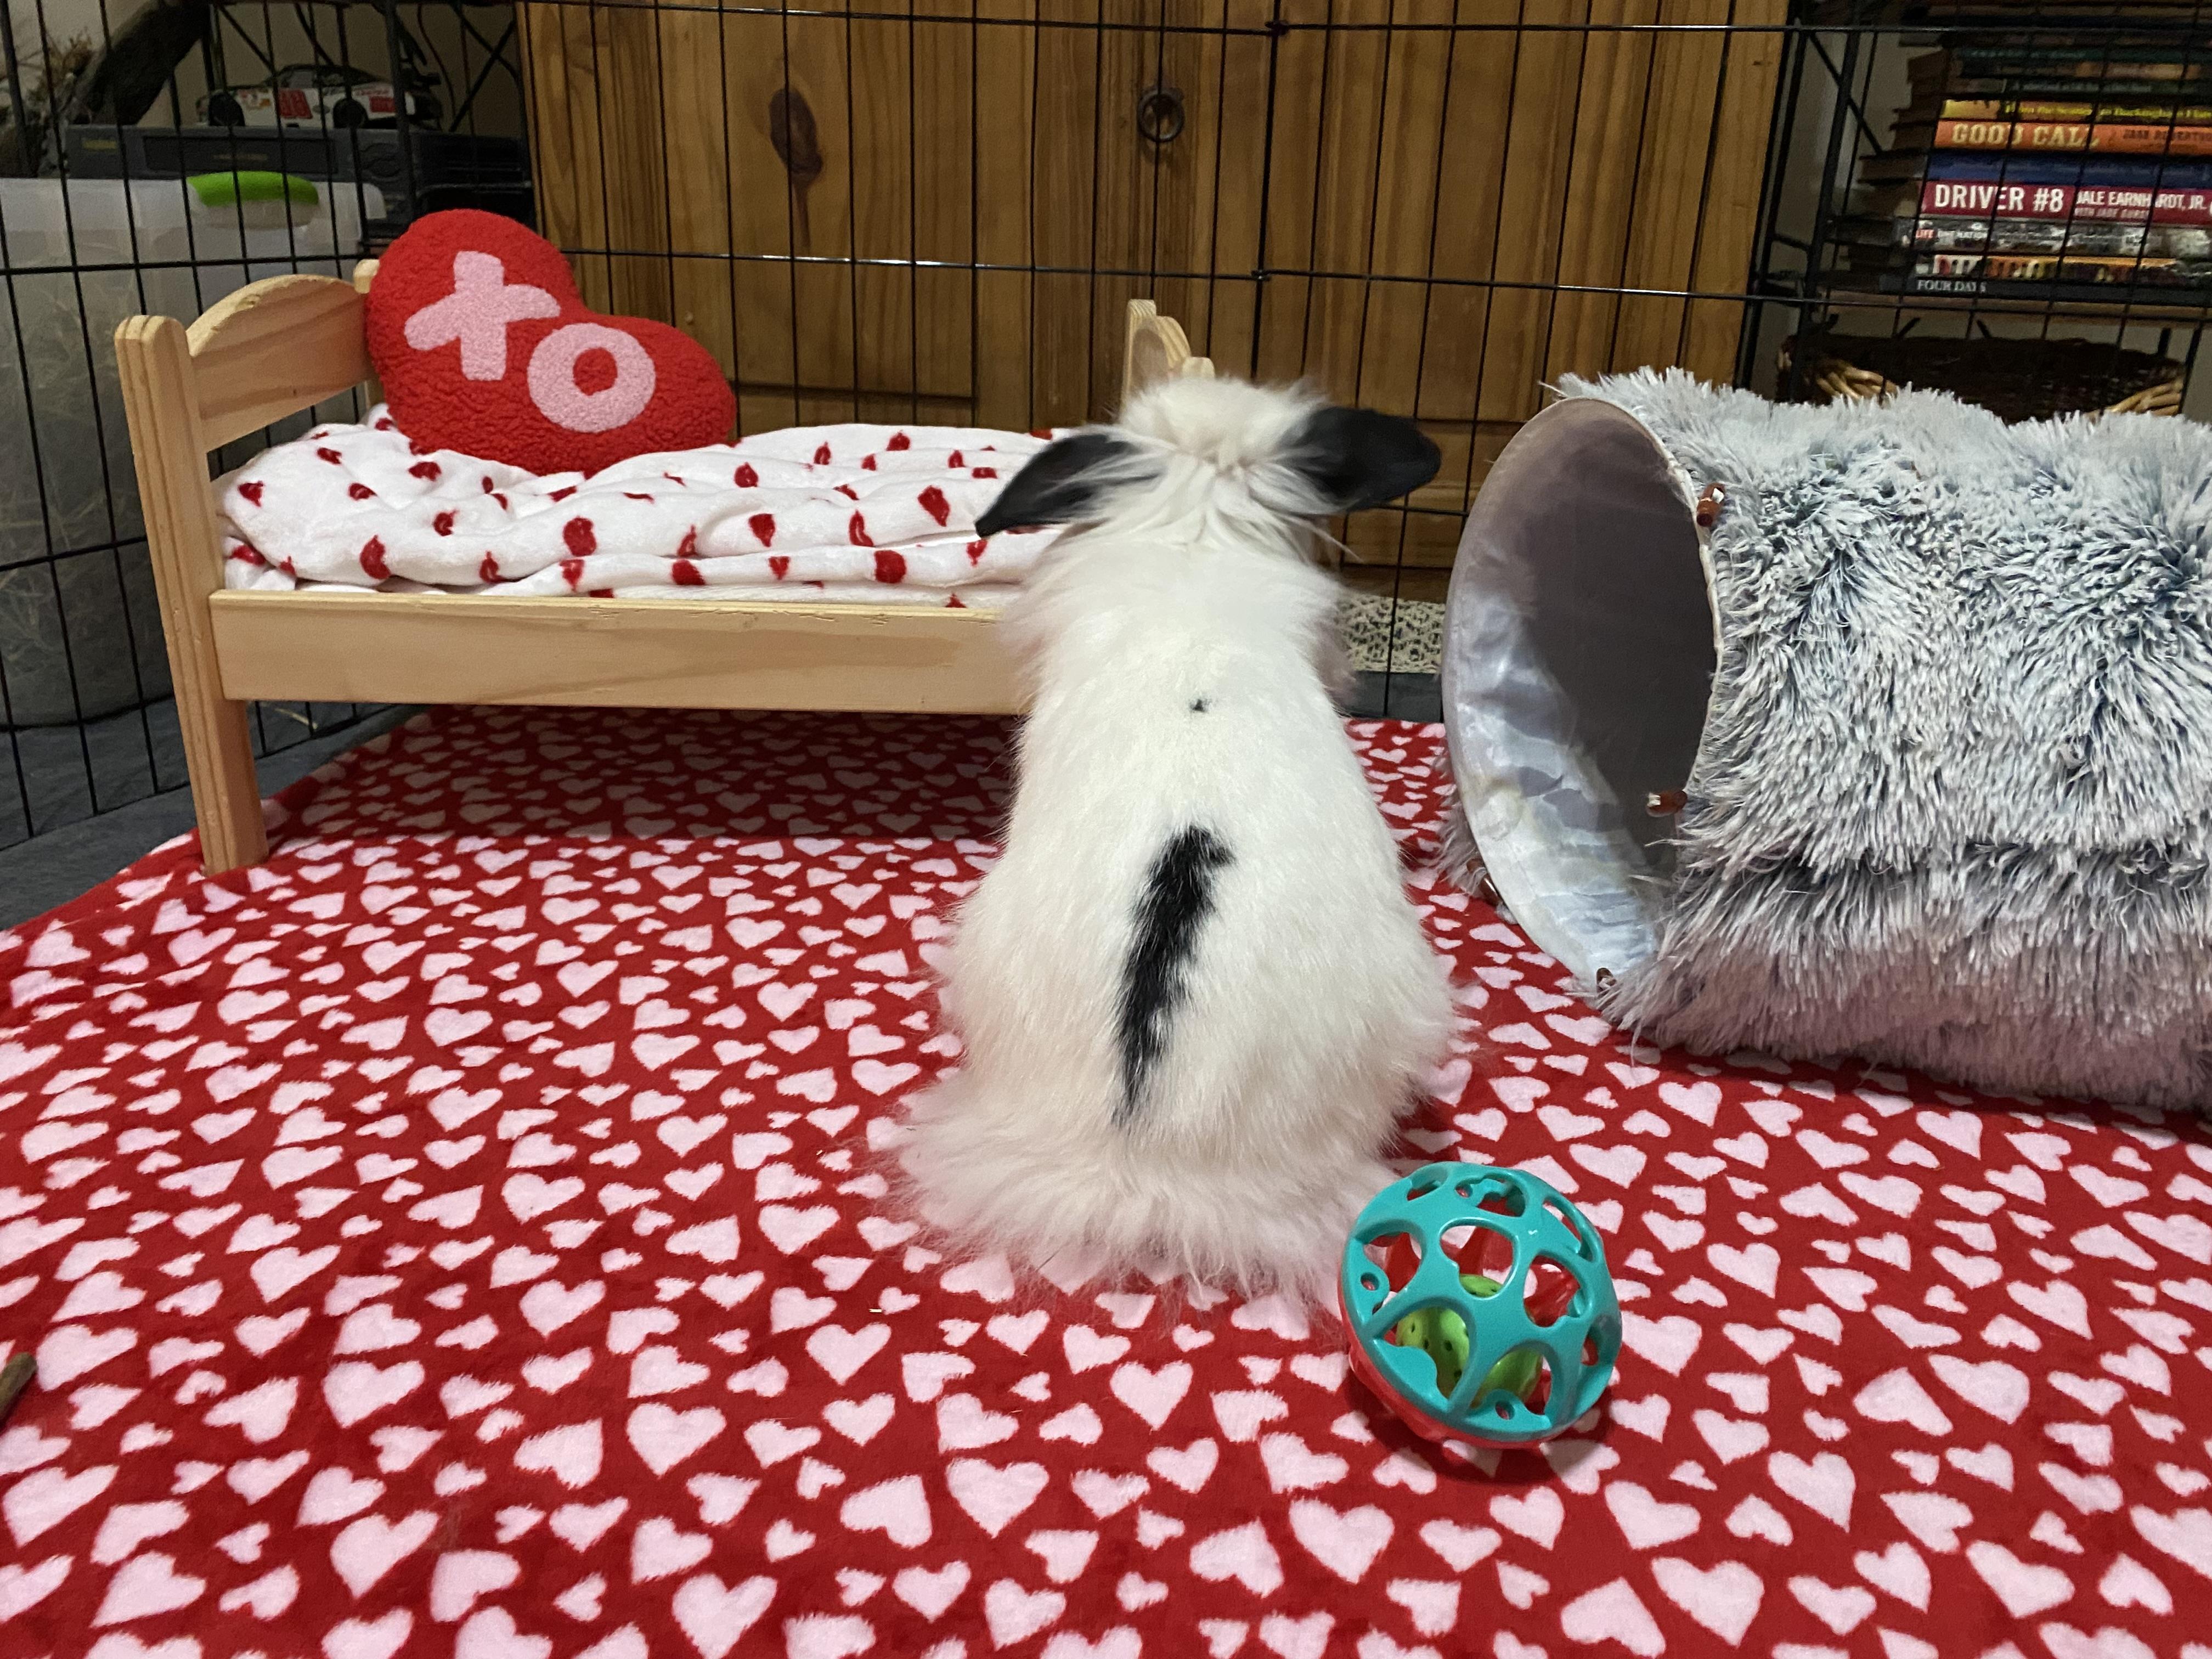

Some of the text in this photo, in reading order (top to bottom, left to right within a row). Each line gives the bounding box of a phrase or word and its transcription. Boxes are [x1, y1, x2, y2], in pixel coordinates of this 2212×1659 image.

[1952, 123, 2024, 145] GOOD
[1934, 184, 2064, 213] DRIVER #8
[2188, 195, 2208, 210] JR.
[1916, 279, 1953, 291] FOUR
